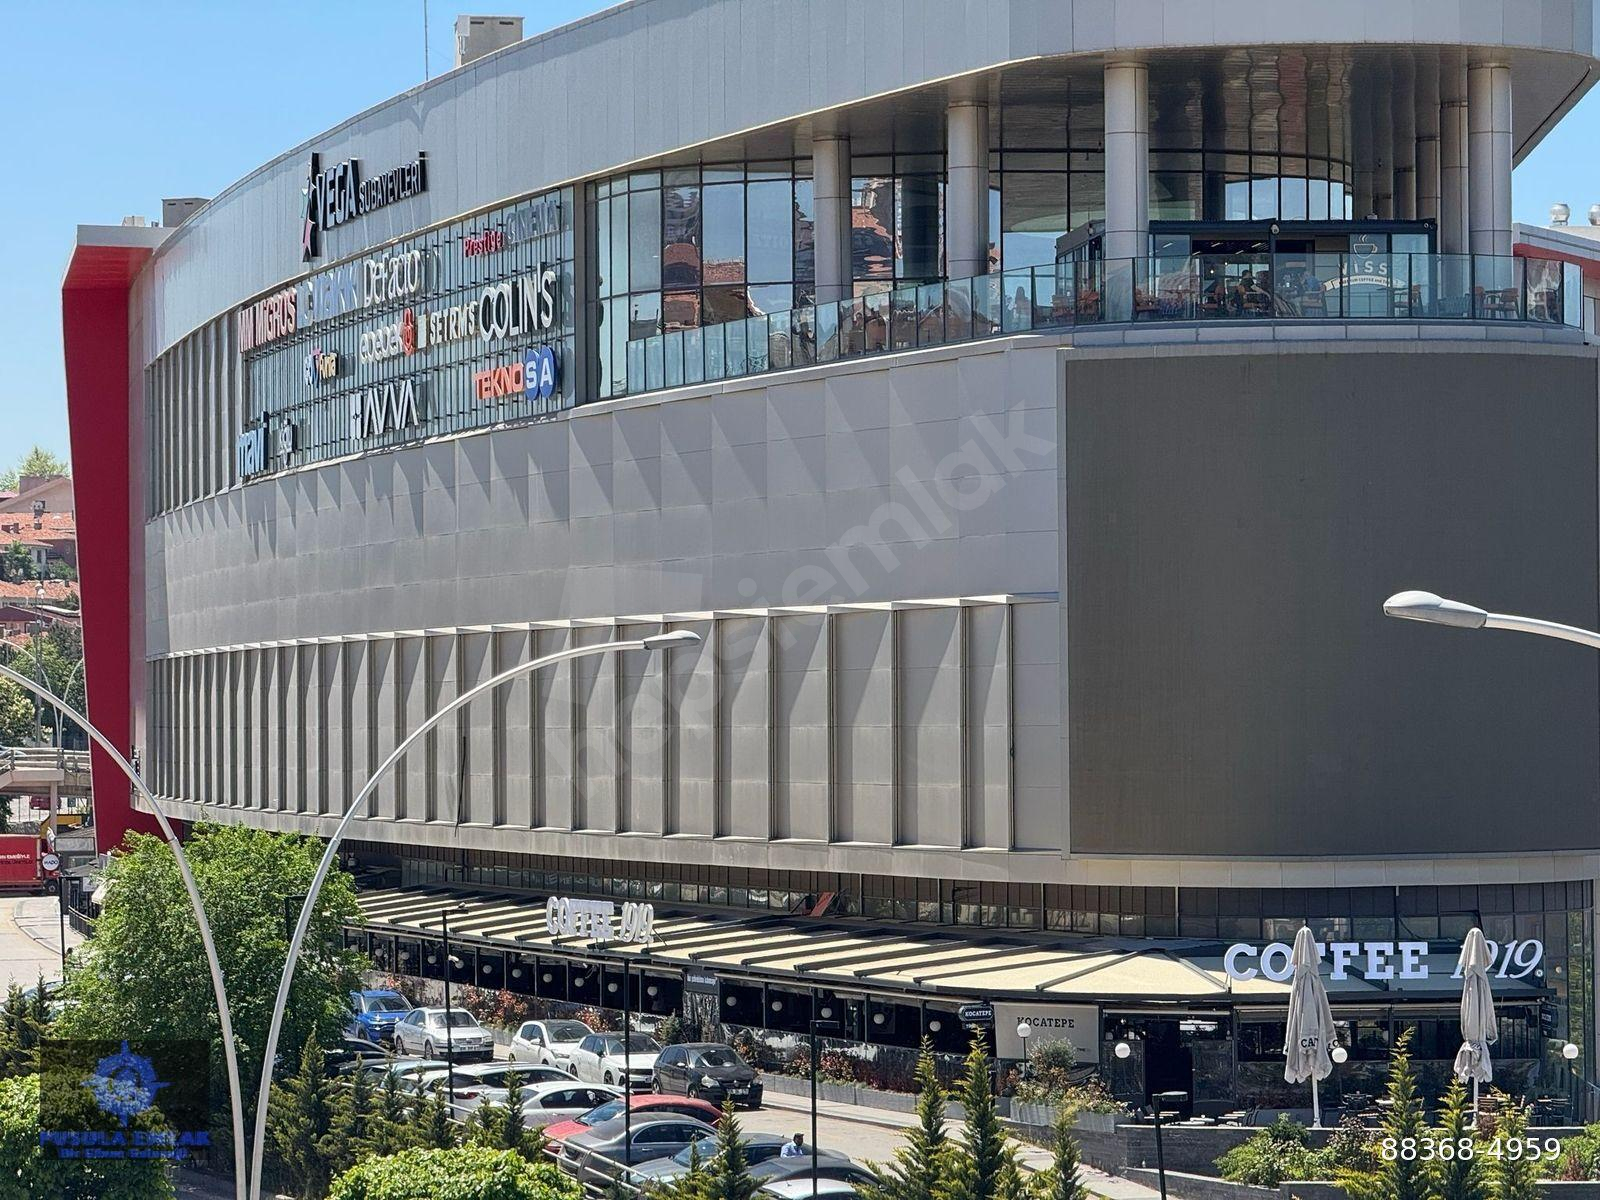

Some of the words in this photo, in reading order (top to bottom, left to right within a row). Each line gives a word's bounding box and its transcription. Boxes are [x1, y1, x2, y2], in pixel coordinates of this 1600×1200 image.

[316, 158, 358, 230] VEGA
[479, 261, 557, 342] COLIN'S
[473, 357, 554, 400] TEKNOSA
[1223, 941, 1429, 981] COFEE
